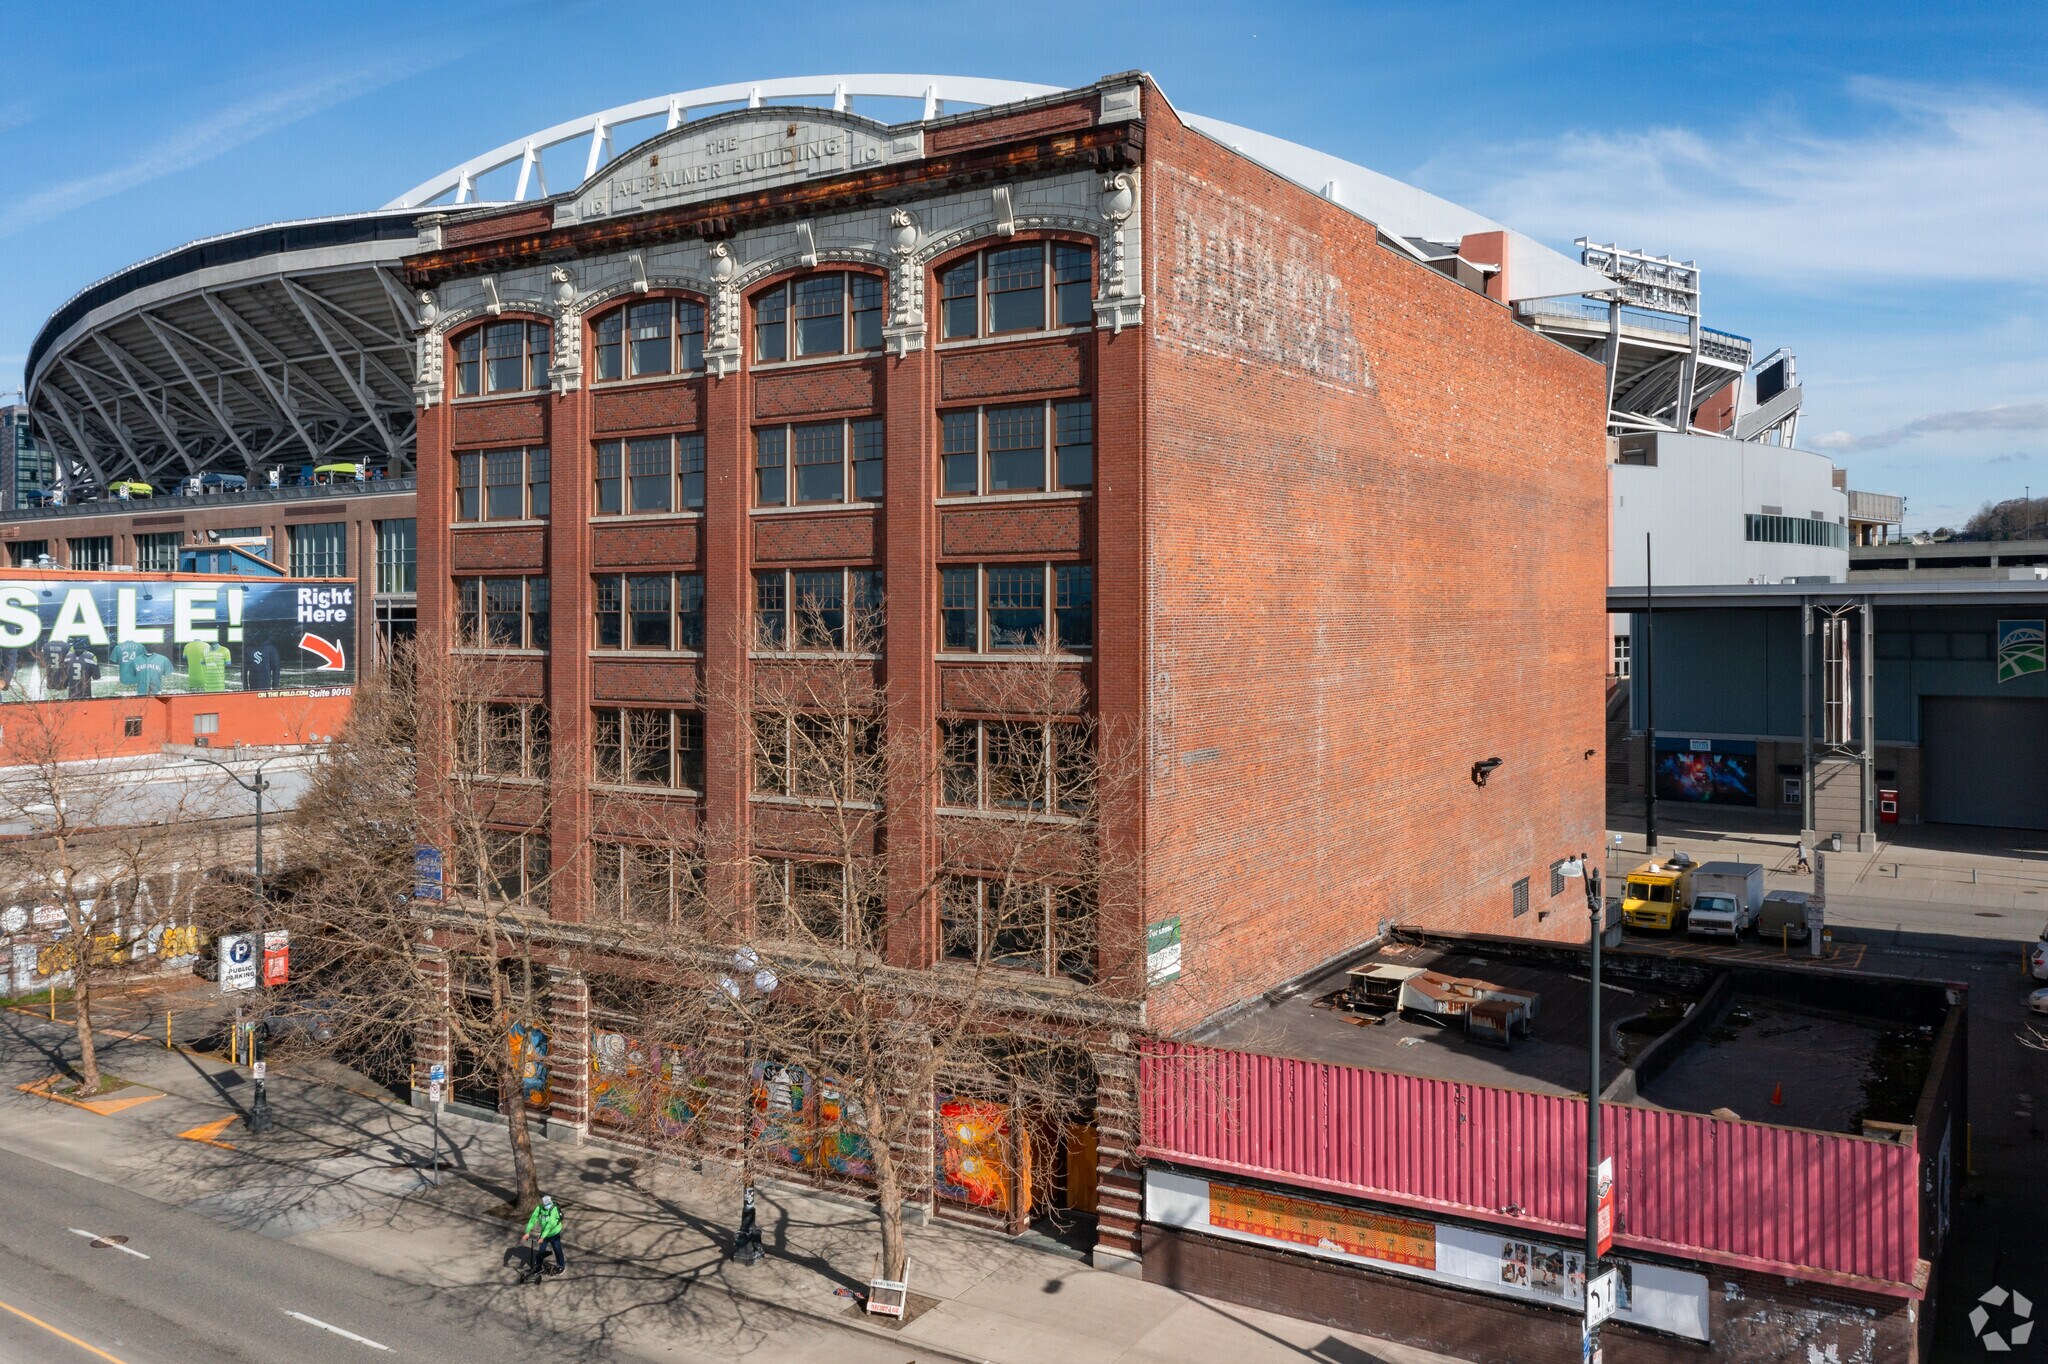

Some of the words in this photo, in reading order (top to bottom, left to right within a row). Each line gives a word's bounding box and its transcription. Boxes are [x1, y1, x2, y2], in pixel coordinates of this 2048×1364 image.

[706, 136, 738, 156] THE
[733, 139, 839, 174] BUILDING
[858, 147, 879, 164] 10
[589, 200, 603, 215] 19
[297, 588, 352, 609] Right
[0, 587, 244, 648] SALE!
[297, 605, 347, 622] Here
[50, 652, 60, 669] 3
[122, 651, 136, 663] 24
[72, 662, 82, 680] 3
[309, 688, 329, 698] Suite
[331, 687, 352, 697] 901B
[40, 913, 62, 921] OPEN
[226, 971, 255, 981] PARKING
[229, 965, 253, 973] PUBLIC
